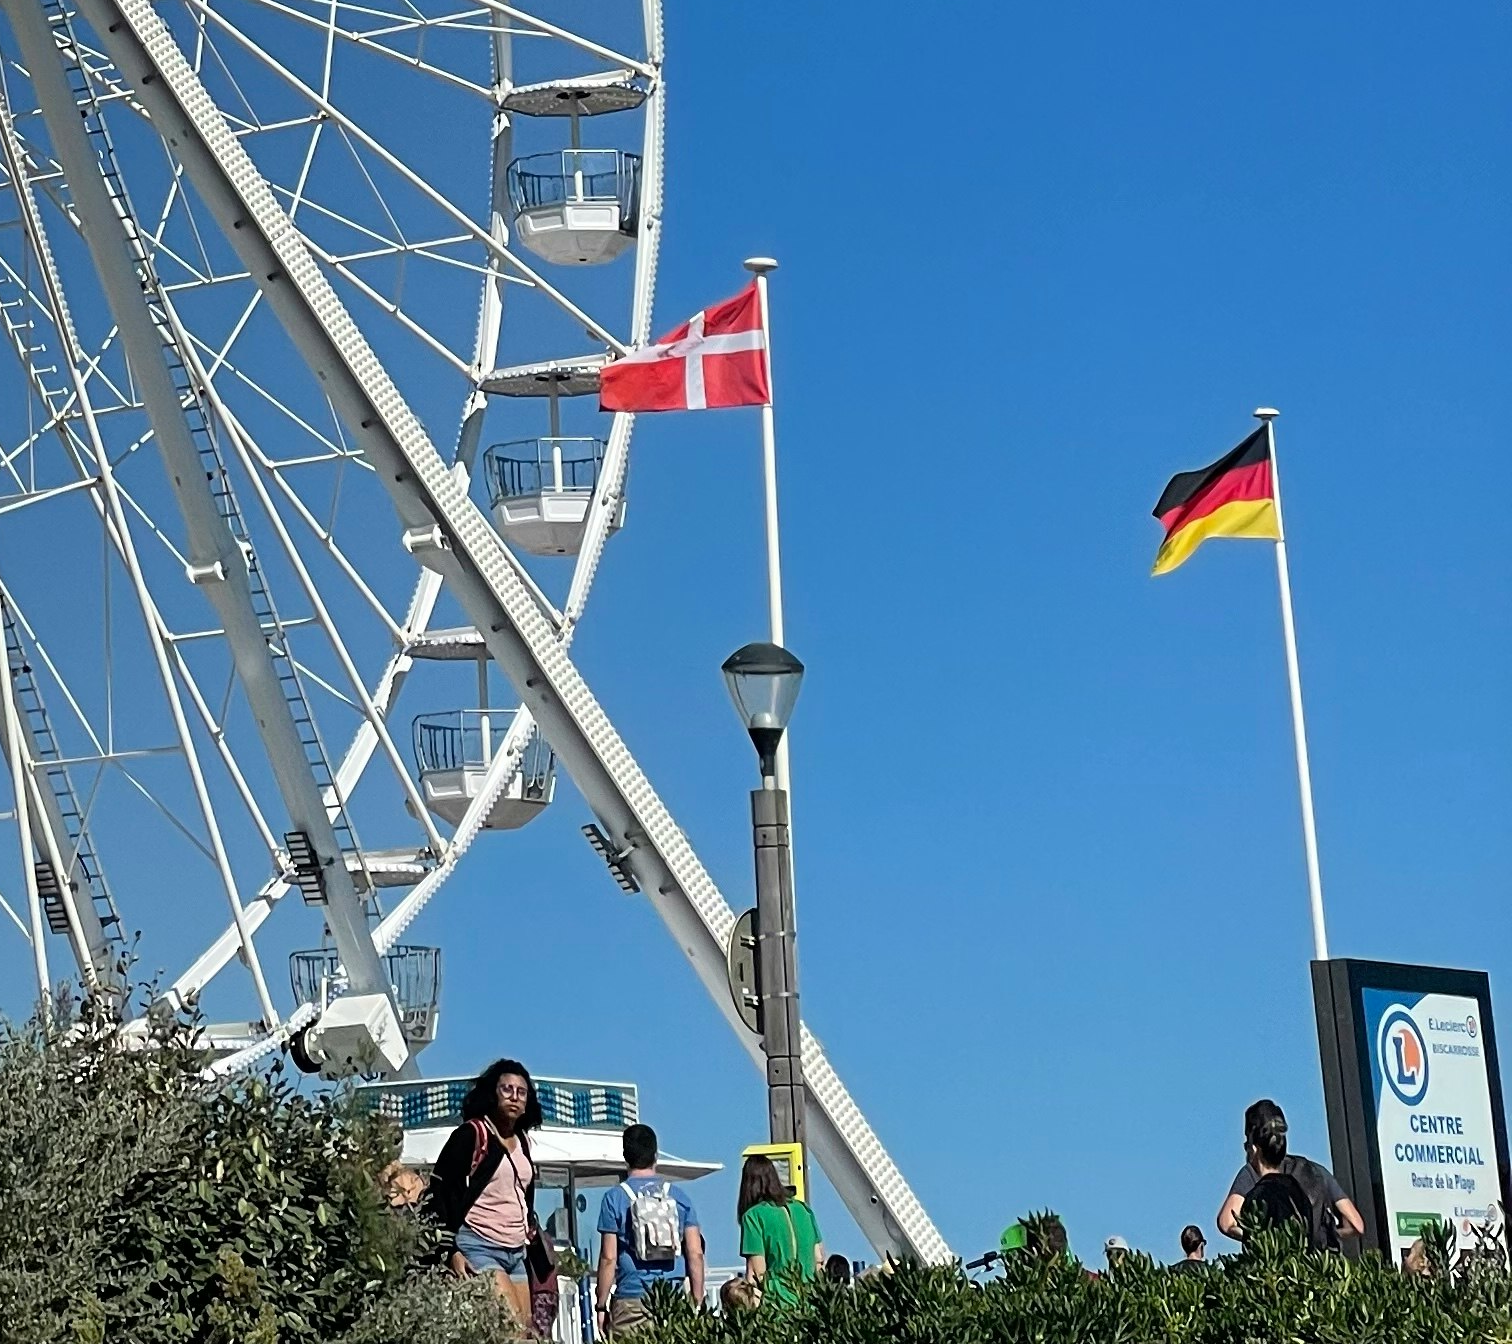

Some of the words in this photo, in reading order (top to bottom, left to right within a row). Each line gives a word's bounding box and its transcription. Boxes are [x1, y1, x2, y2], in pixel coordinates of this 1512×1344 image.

[1410, 1114, 1464, 1135] CENTRE
[1394, 1143, 1485, 1166] COMMERCIAL
[1411, 1172, 1433, 1189] Route
[1435, 1173, 1444, 1189] de
[1445, 1173, 1454, 1190] la
